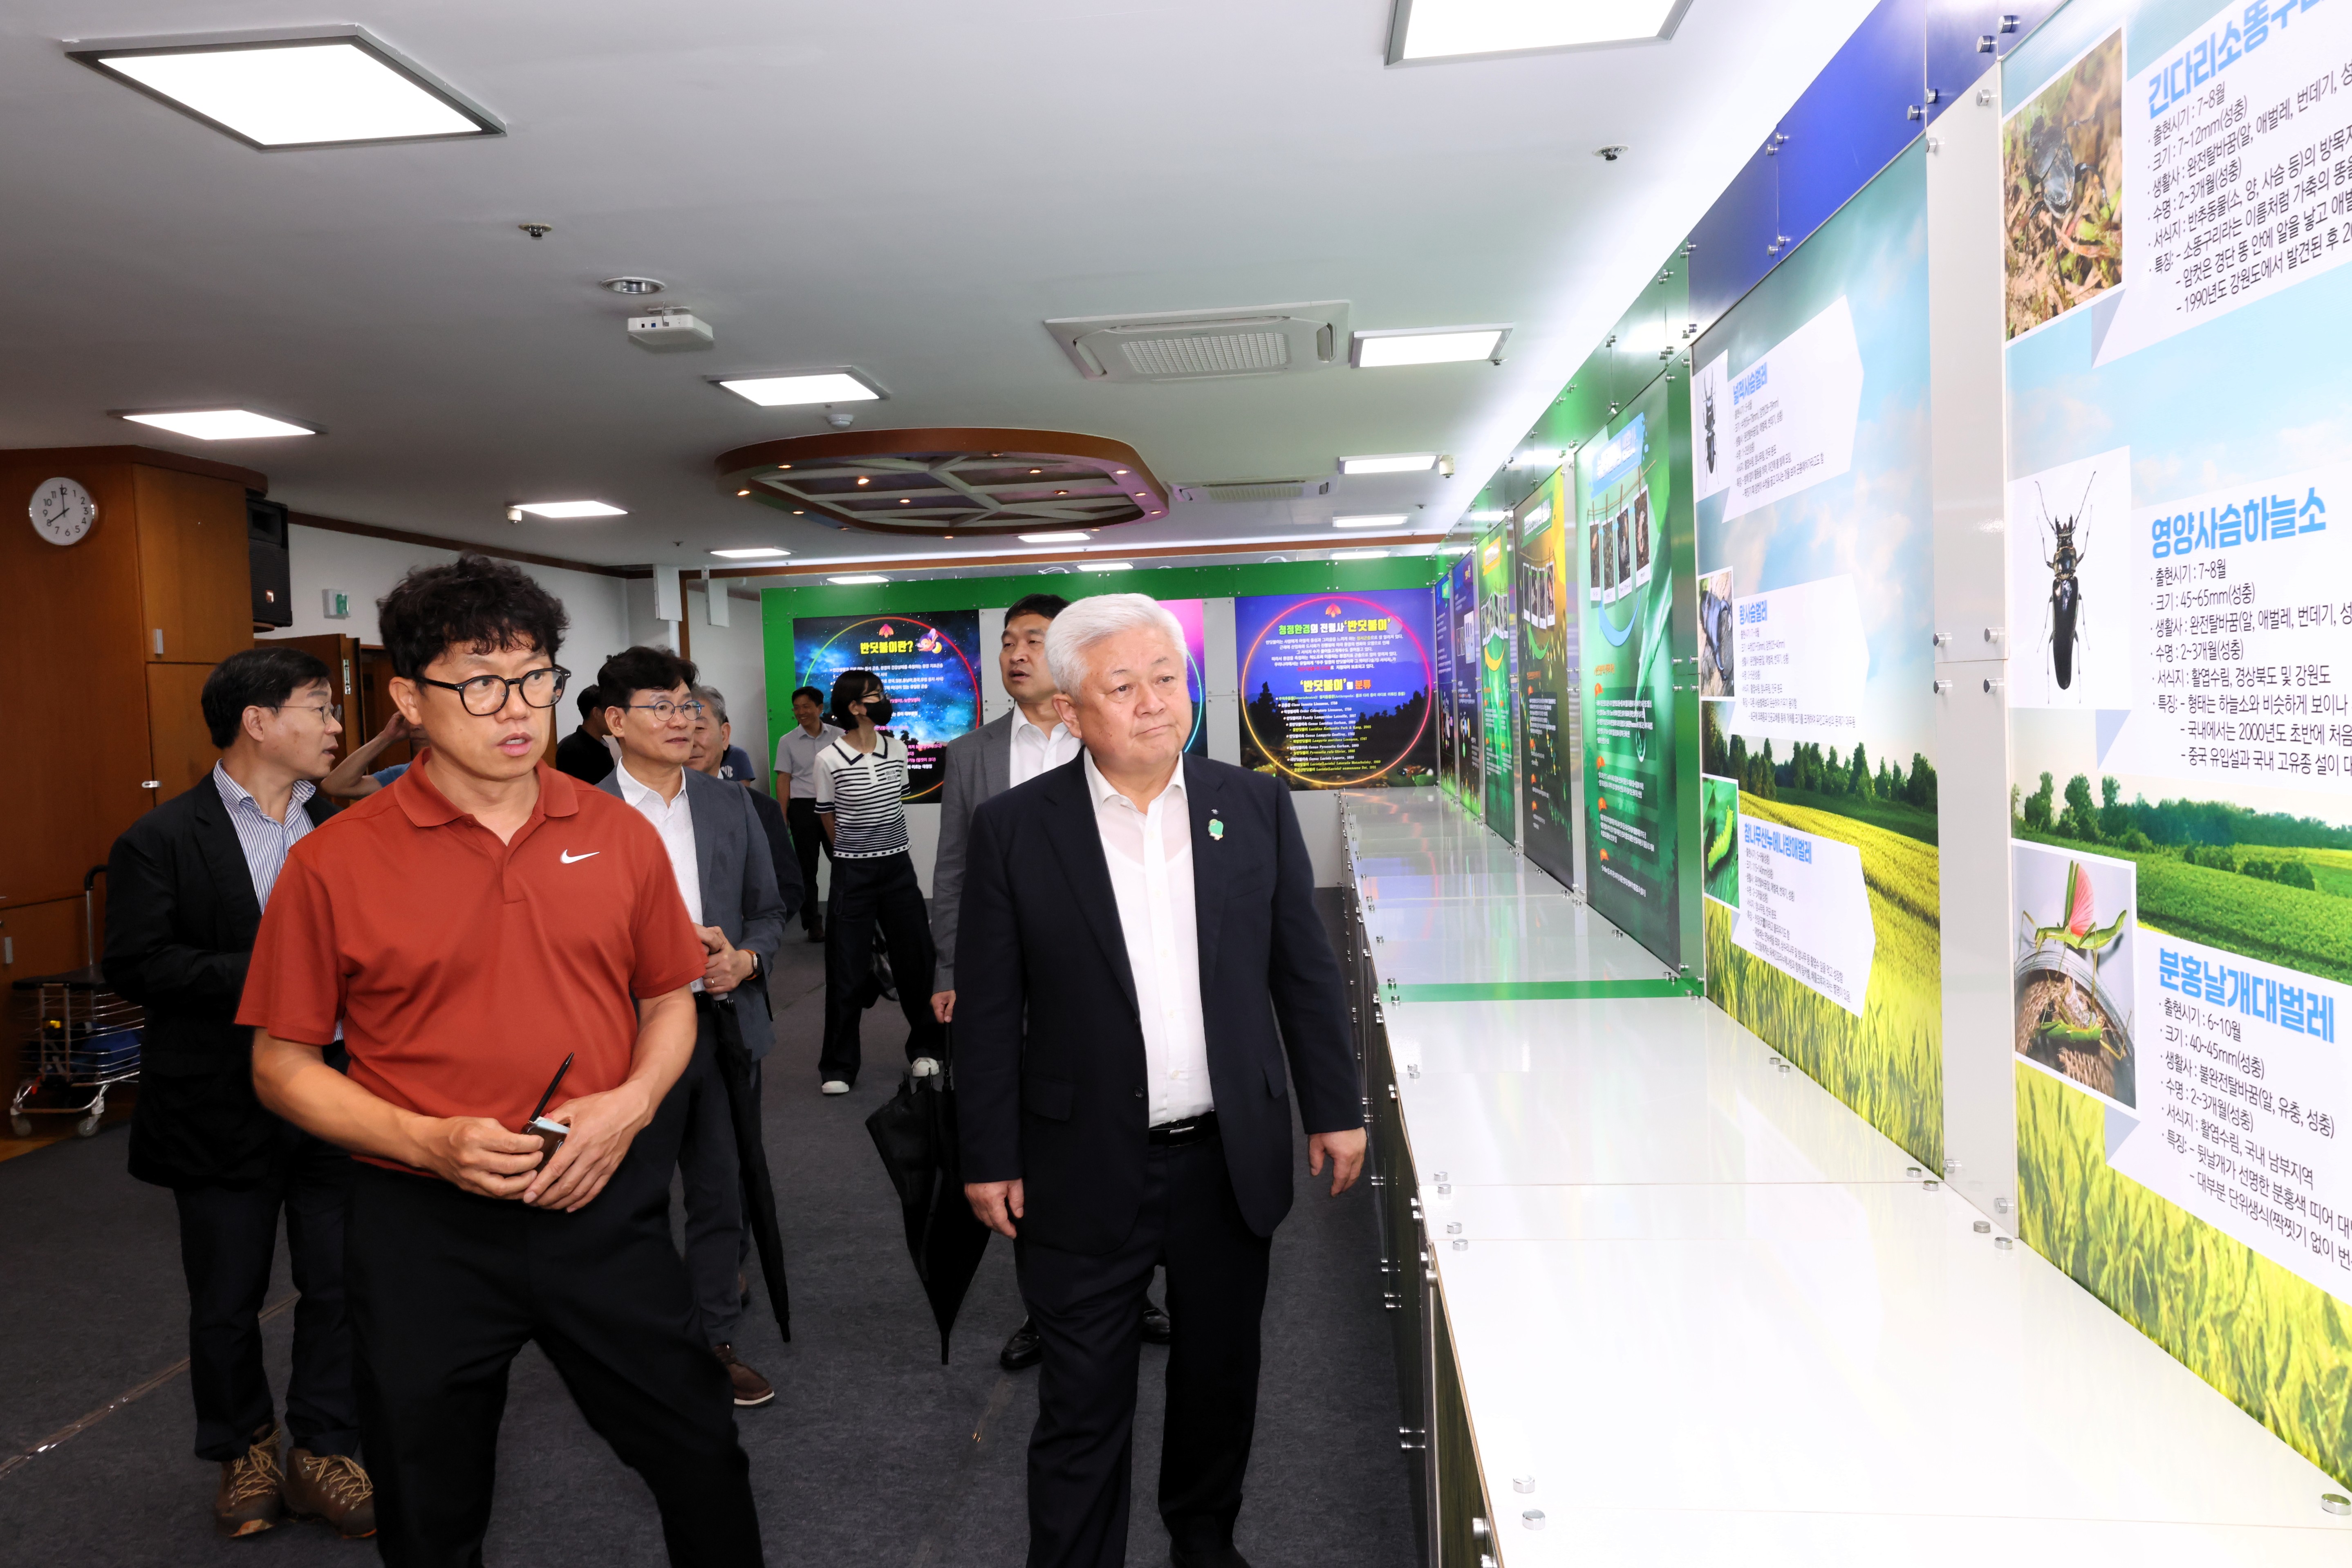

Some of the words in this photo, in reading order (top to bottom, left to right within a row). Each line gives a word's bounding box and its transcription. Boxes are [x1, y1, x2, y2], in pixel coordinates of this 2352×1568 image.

[2153, 106, 2188, 146] 출현시기
[2197, 81, 2224, 115] 7~8월
[2153, 145, 2170, 171] 크기
[2153, 166, 2180, 198] 생활사
[2154, 219, 2180, 248] 서식지
[2262, 164, 2285, 189] 사슴
[2288, 144, 2315, 179] 등)의
[2153, 198, 2171, 223] 수명
[2183, 217, 2242, 260] 소똥구리라는
[2246, 189, 2289, 227] 이름처럼
[2294, 168, 2329, 203] 가축의
[2184, 258, 2212, 288] 암컷은
[2215, 246, 2235, 273] 경단
[2238, 240, 2249, 262] 똥
[2252, 227, 2273, 256] 안에
[2277, 215, 2300, 244] 알을
[2304, 202, 2328, 231] 낳고
[2185, 279, 2227, 312] 1990년도
[2230, 252, 2282, 294] 강원도에서
[2287, 233, 2322, 269] 발견된
[2326, 227, 2339, 251] 후
[2153, 488, 2325, 558] 영양사슴하늘소
[2156, 564, 2190, 587] 출현시기
[2199, 559, 2226, 579] 7~8월
[1739, 600, 1767, 625] 왕사슴벌레
[2156, 593, 2173, 611] 크기
[1279, 623, 1318, 635] 청정환경의
[2156, 618, 2182, 638] 생활사
[860, 641, 914, 654] 반딧불이란?
[2156, 644, 2173, 663] 수명
[2158, 669, 2184, 688] 서식지
[2236, 667, 2277, 687] 경상북도
[2281, 665, 2291, 686] 및
[2296, 665, 2331, 686] 강원도
[2188, 694, 2216, 714] 형태는
[2219, 694, 2260, 715] 하늘소와
[2263, 694, 2307, 715] 비슷하게
[2311, 694, 2348, 716] 보이나
[2188, 721, 2236, 741] 국내에서는
[2239, 723, 2287, 743] 2000년도
[2290, 724, 2324, 746] 초반에
[2188, 747, 2207, 766] 중국
[2210, 748, 2250, 769] 유입설과
[2253, 750, 2274, 771] 국내
[2278, 753, 2312, 774] 고유종
[2315, 754, 2339, 776] 설이
[1744, 822, 1812, 865] 참나무산누에나방애벌레
[2159, 948, 2334, 1043] 분홍날개대벌레
[2164, 997, 2200, 1027] 출현시기
[2208, 1014, 2241, 1042] 6~10월
[2166, 1025, 2182, 1047] 크기
[2166, 1078, 2183, 1100] 수명
[2166, 1051, 2192, 1077] 생활사
[2307, 1109, 2334, 1139] 성충)
[2167, 1104, 2193, 1131] 서식지
[2245, 1140, 2265, 1167] 국내
[2269, 1151, 2313, 1190] 남부지역
[2197, 1145, 2236, 1180] 뒷날개가
[2239, 1166, 2269, 1197] 선명한
[2272, 1182, 2305, 1217] 분홍색
[2310, 1201, 2332, 1231] 띠어
[2198, 1172, 2226, 1202] 대부분
[2311, 1232, 2334, 1262] 없이
